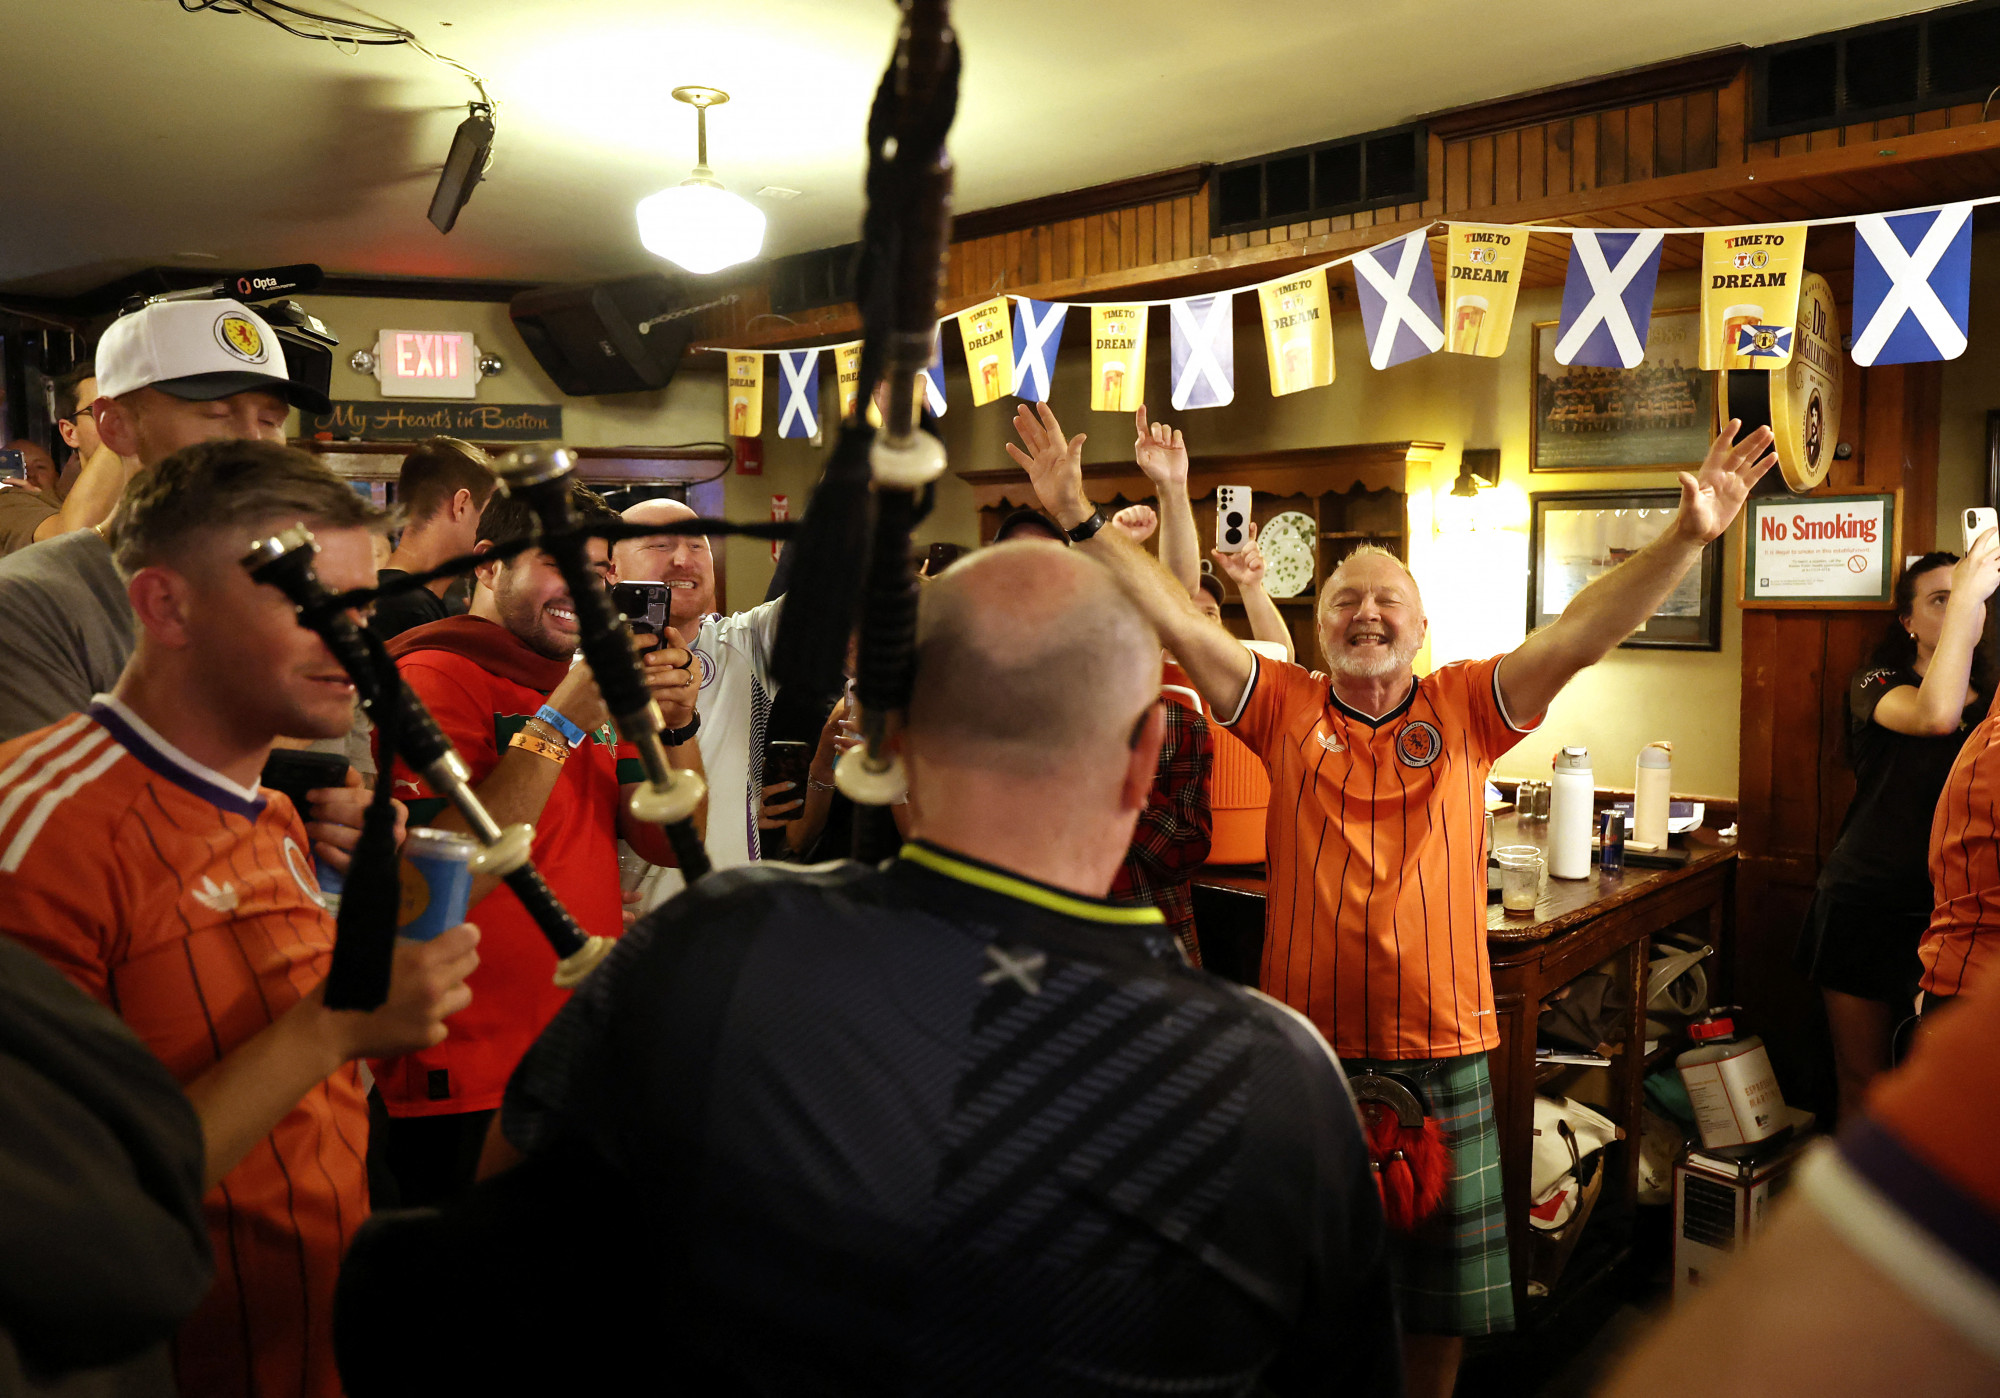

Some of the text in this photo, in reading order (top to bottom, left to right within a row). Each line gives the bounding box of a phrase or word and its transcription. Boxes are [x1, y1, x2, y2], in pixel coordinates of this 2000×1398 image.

[1464, 232, 1511, 246] TIME TO
[1725, 234, 1784, 249] TIME TO
[1451, 266, 1509, 283] DREAM
[1712, 272, 1787, 289] DREAM
[253, 277, 277, 291] Opta
[1272, 280, 1312, 298] TIME TO
[969, 306, 998, 323] TIME TO
[1102, 309, 1136, 319] TIME TO
[1271, 307, 1320, 329] DREAM
[1812, 297, 1828, 343] DR.
[969, 330, 1004, 351] DREAM
[1096, 338, 1136, 350] DREAM
[395, 333, 463, 378] EXIT
[729, 378, 756, 388] DREAM
[314, 405, 550, 435] My Heart's in Boston
[1761, 512, 1878, 543] No Smoking
